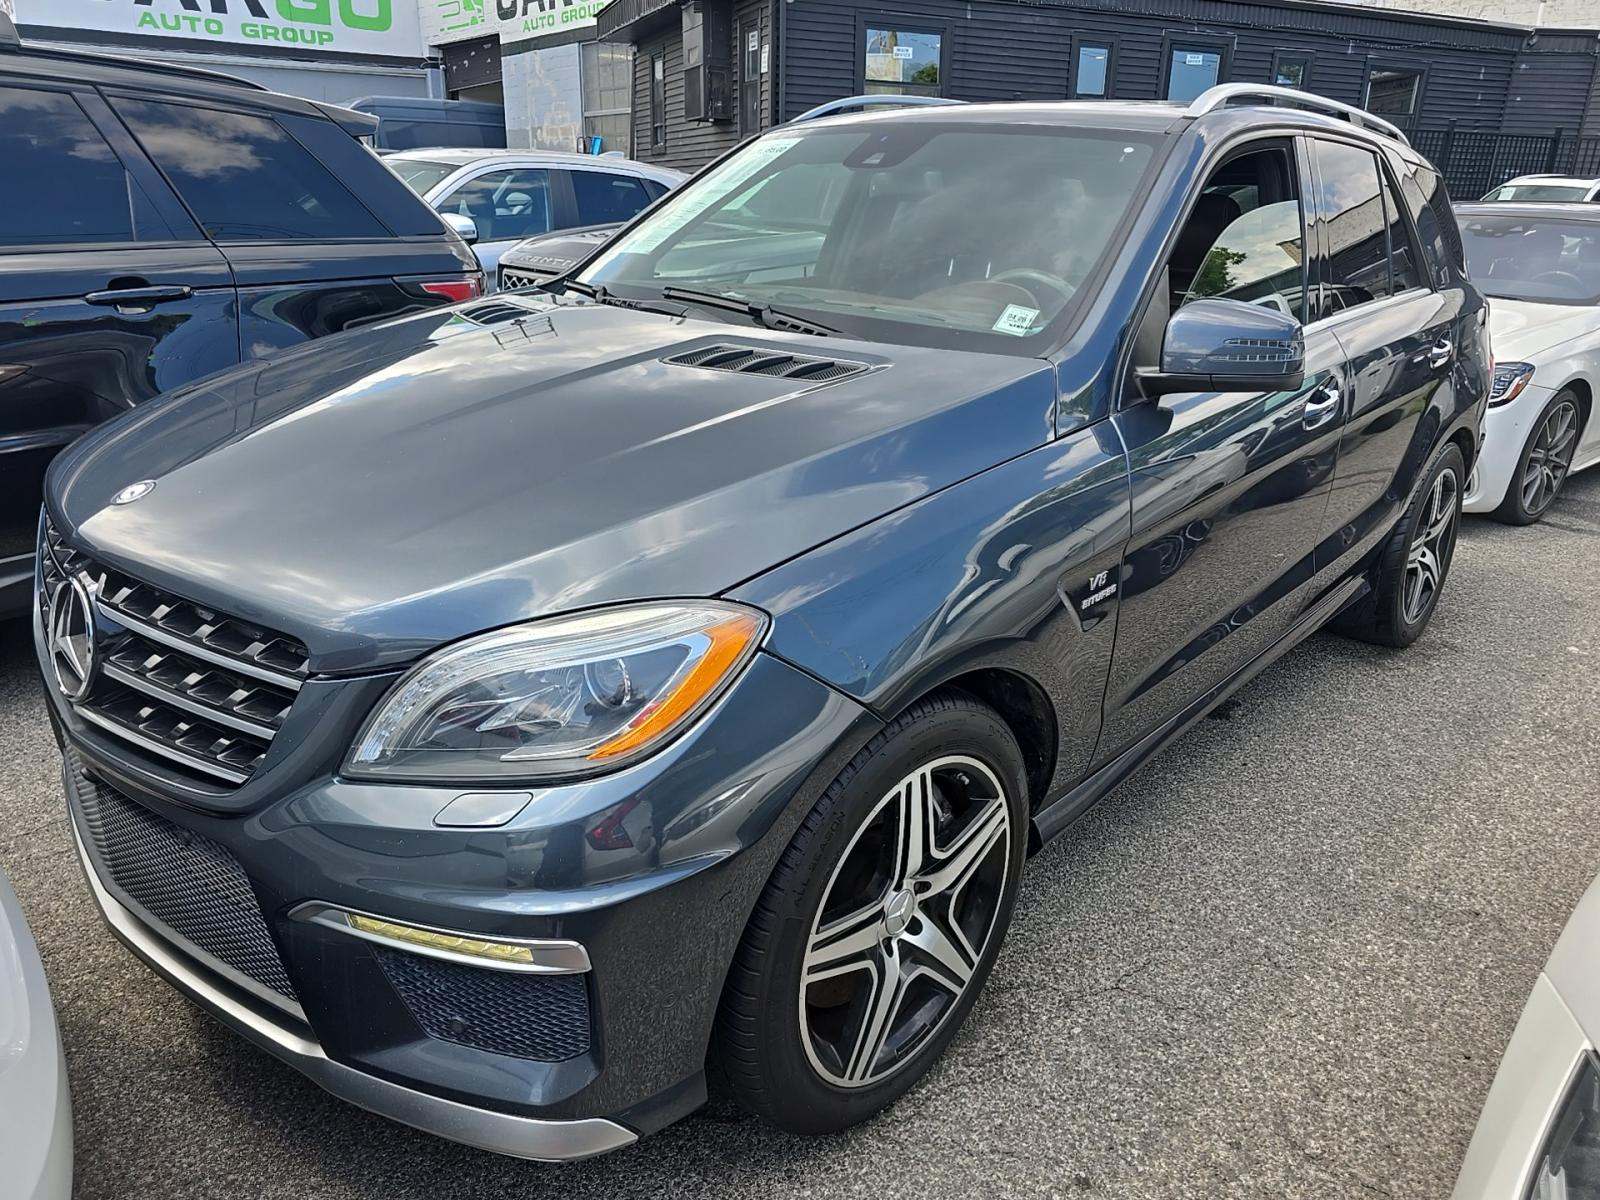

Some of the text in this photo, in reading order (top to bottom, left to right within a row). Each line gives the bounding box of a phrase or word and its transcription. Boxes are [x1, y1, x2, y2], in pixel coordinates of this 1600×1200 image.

[137, 11, 224, 36] AUTO
[240, 22, 335, 46] GROUP
[522, 14, 556, 33] AUTO
